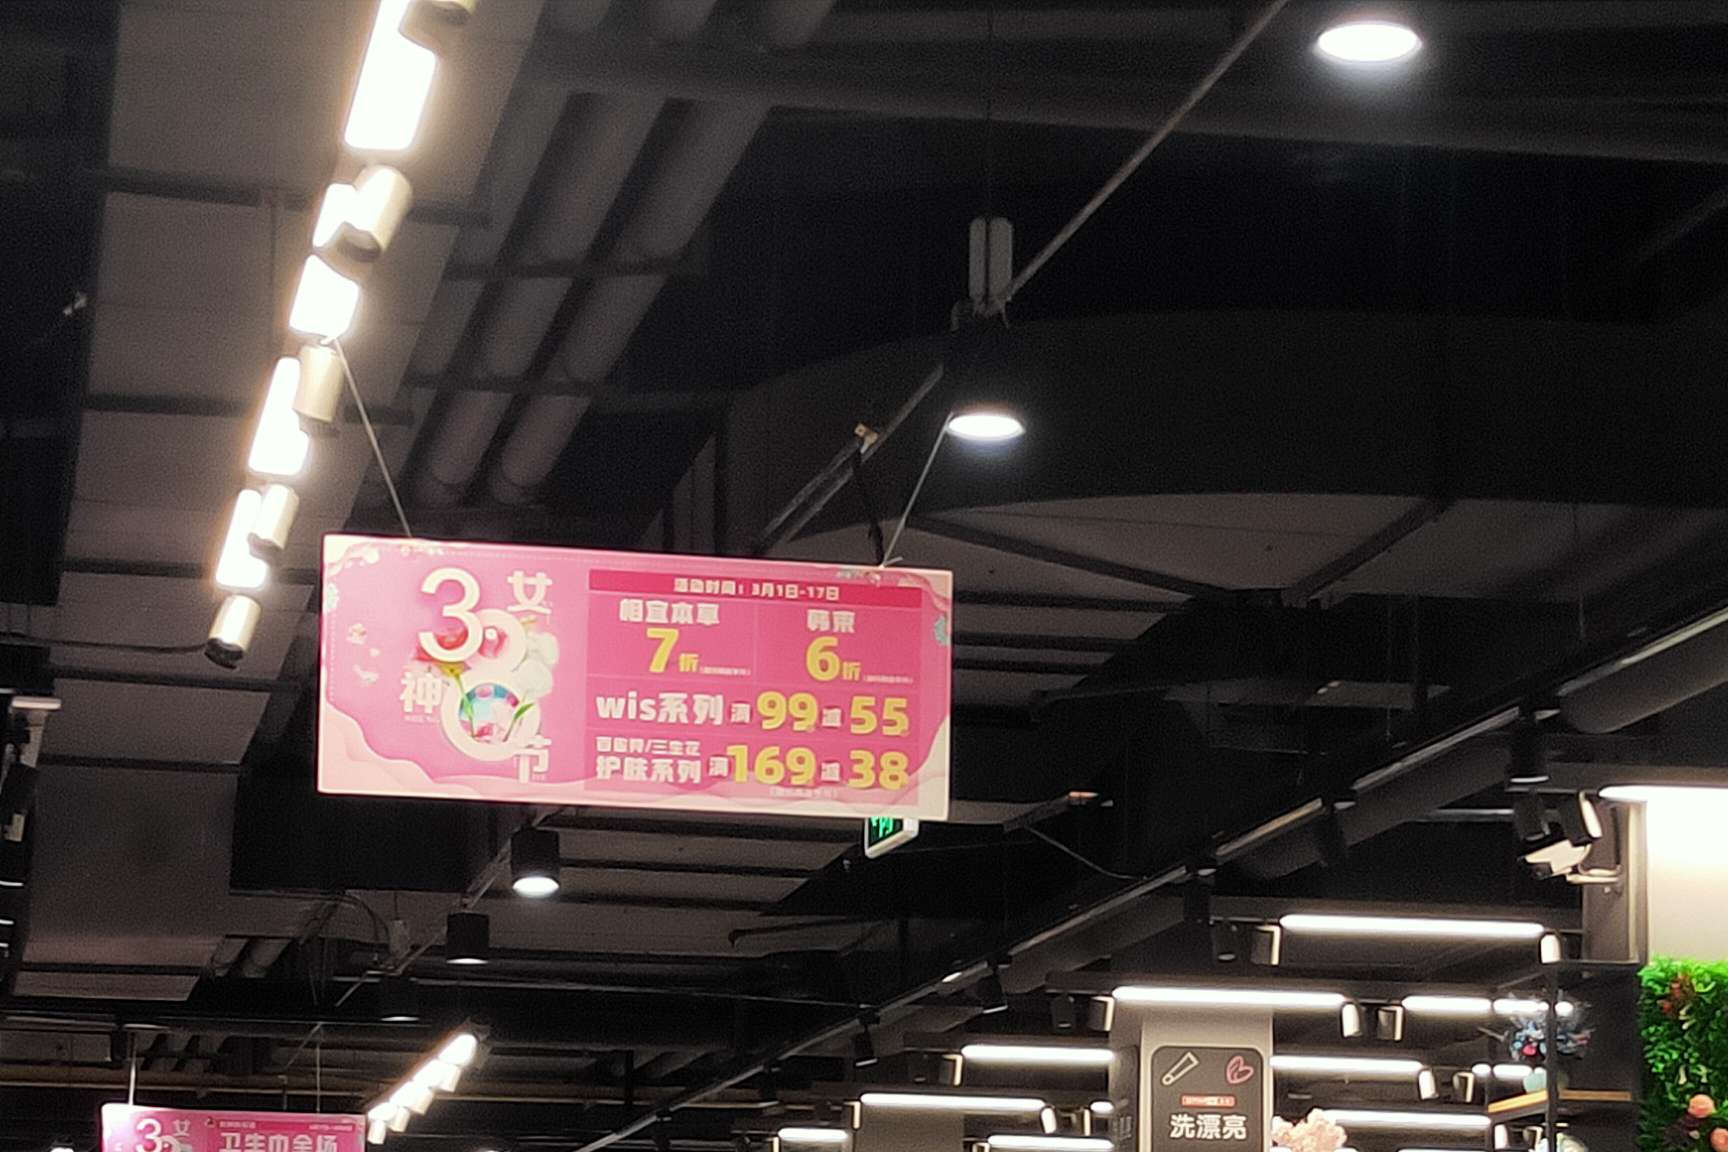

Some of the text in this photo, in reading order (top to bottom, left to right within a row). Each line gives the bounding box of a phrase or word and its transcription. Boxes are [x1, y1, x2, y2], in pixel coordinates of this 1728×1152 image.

[506, 570, 553, 615] 女
[646, 627, 700, 673] 7折
[806, 635, 861, 682] 6折
[1169, 1113, 1249, 1141] 洗漂亮
